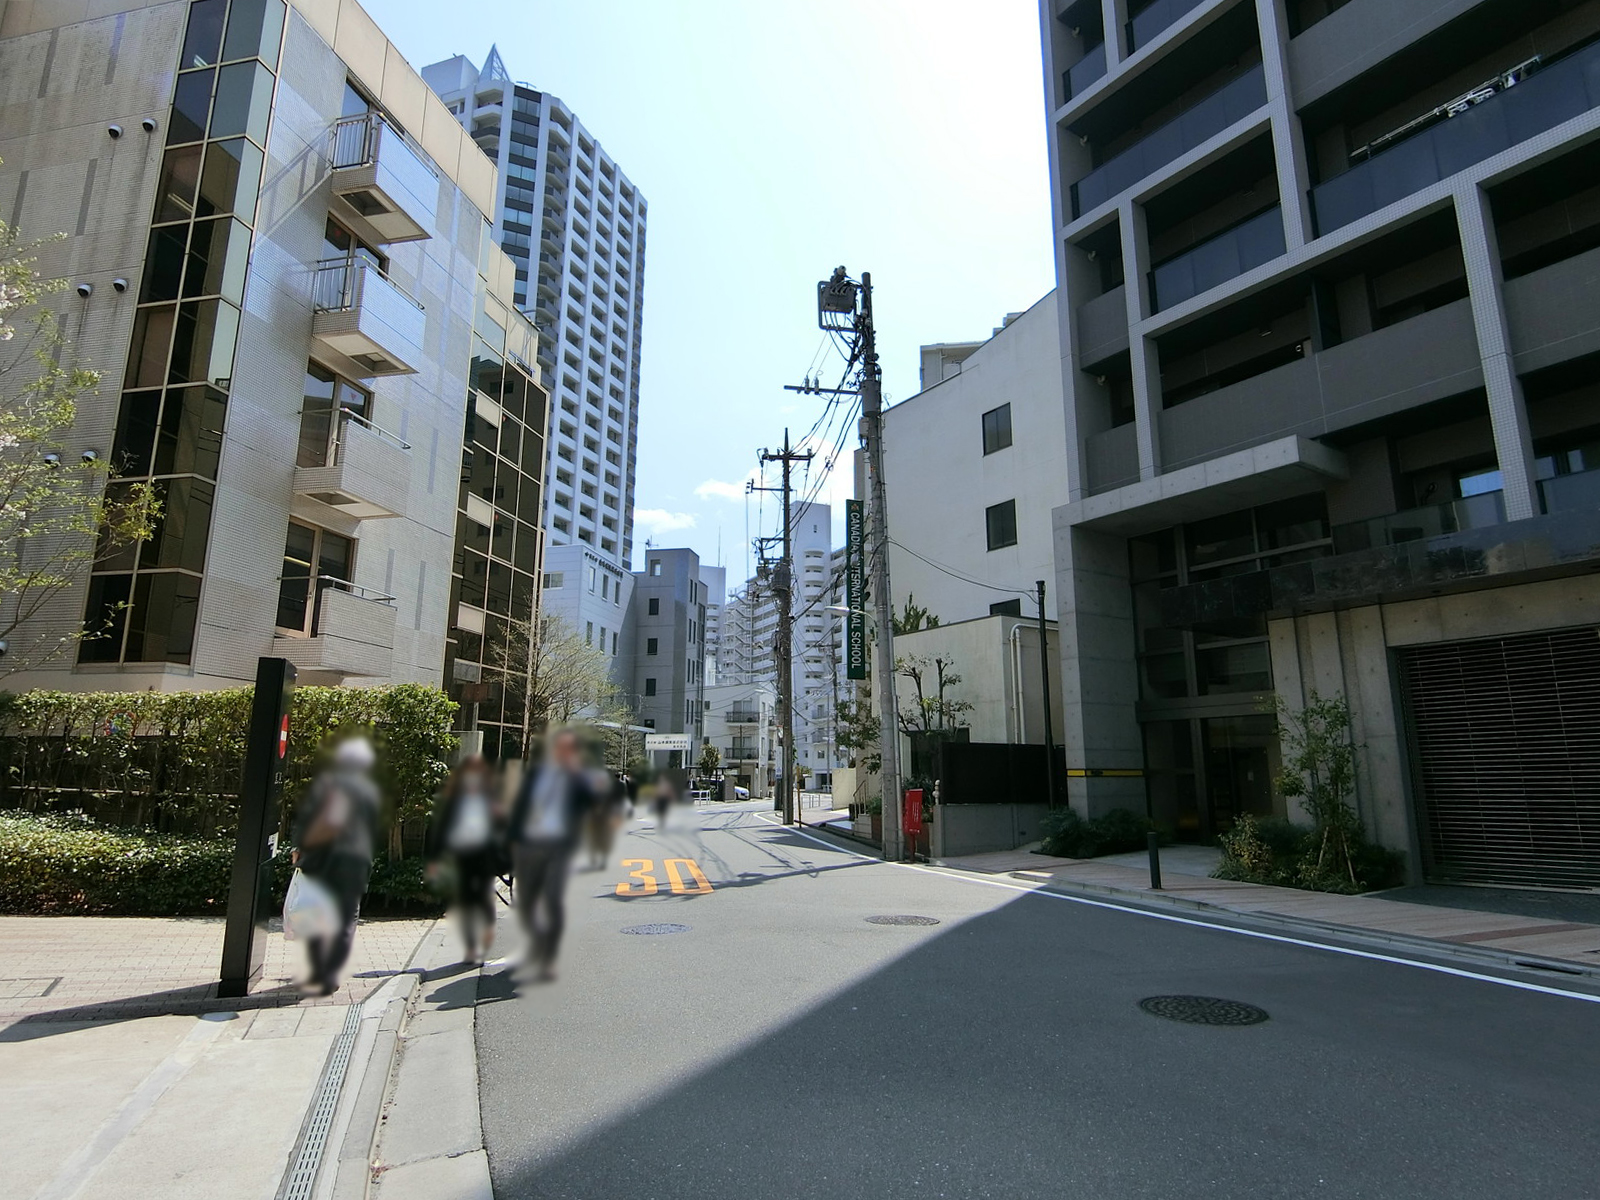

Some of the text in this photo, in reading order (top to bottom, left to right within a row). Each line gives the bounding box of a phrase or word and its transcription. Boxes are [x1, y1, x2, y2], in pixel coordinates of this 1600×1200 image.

[850, 512, 861, 558] CANADIA
[851, 631, 862, 669] SCHOOL
[615, 858, 715, 896] 30
